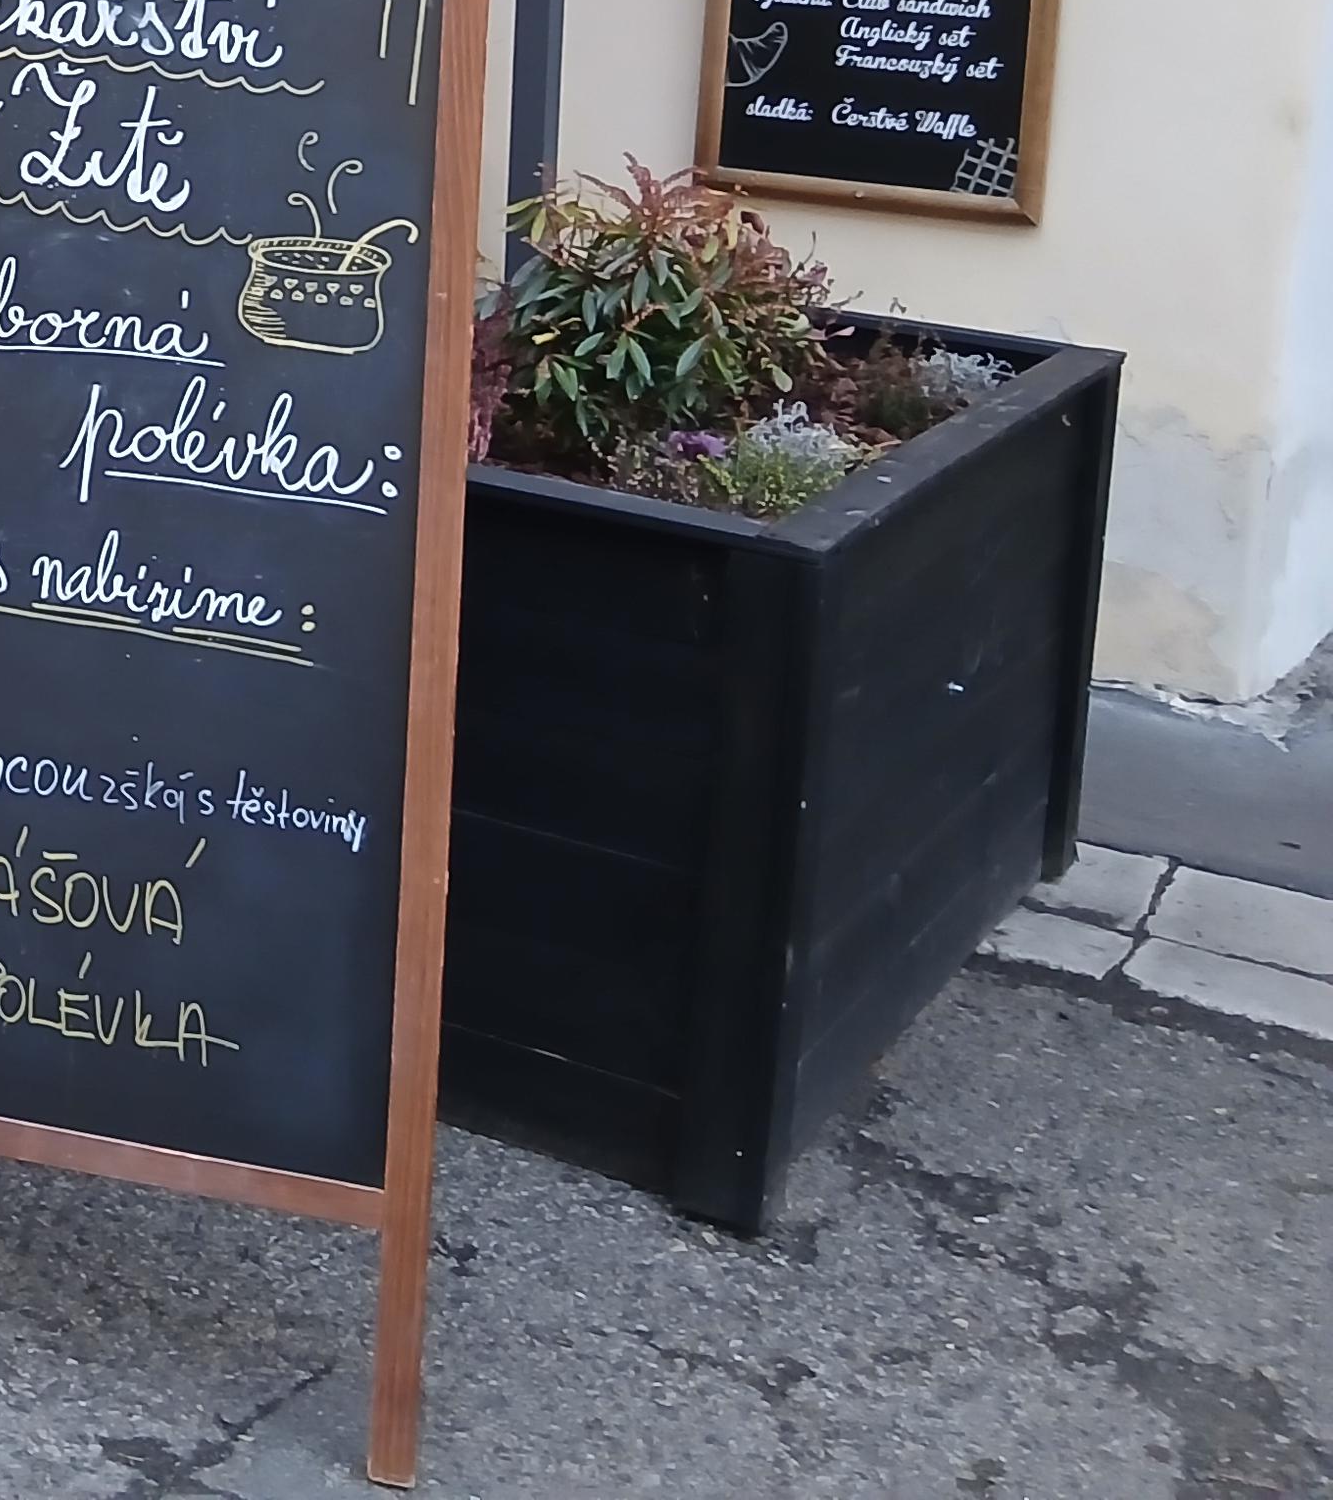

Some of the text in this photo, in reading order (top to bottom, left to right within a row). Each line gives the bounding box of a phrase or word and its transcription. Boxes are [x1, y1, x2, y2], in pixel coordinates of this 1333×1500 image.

[840, 17, 977, 50] Anglický set
[966, 57, 1004, 79] set
[11, 60, 190, 211] Žitě
[746, 95, 977, 139] sladká: Čerstvé Waffle
[60, 376, 402, 502] polévka:
[197, 789, 215, 815] s
[226, 770, 366, 852] těstoviny
